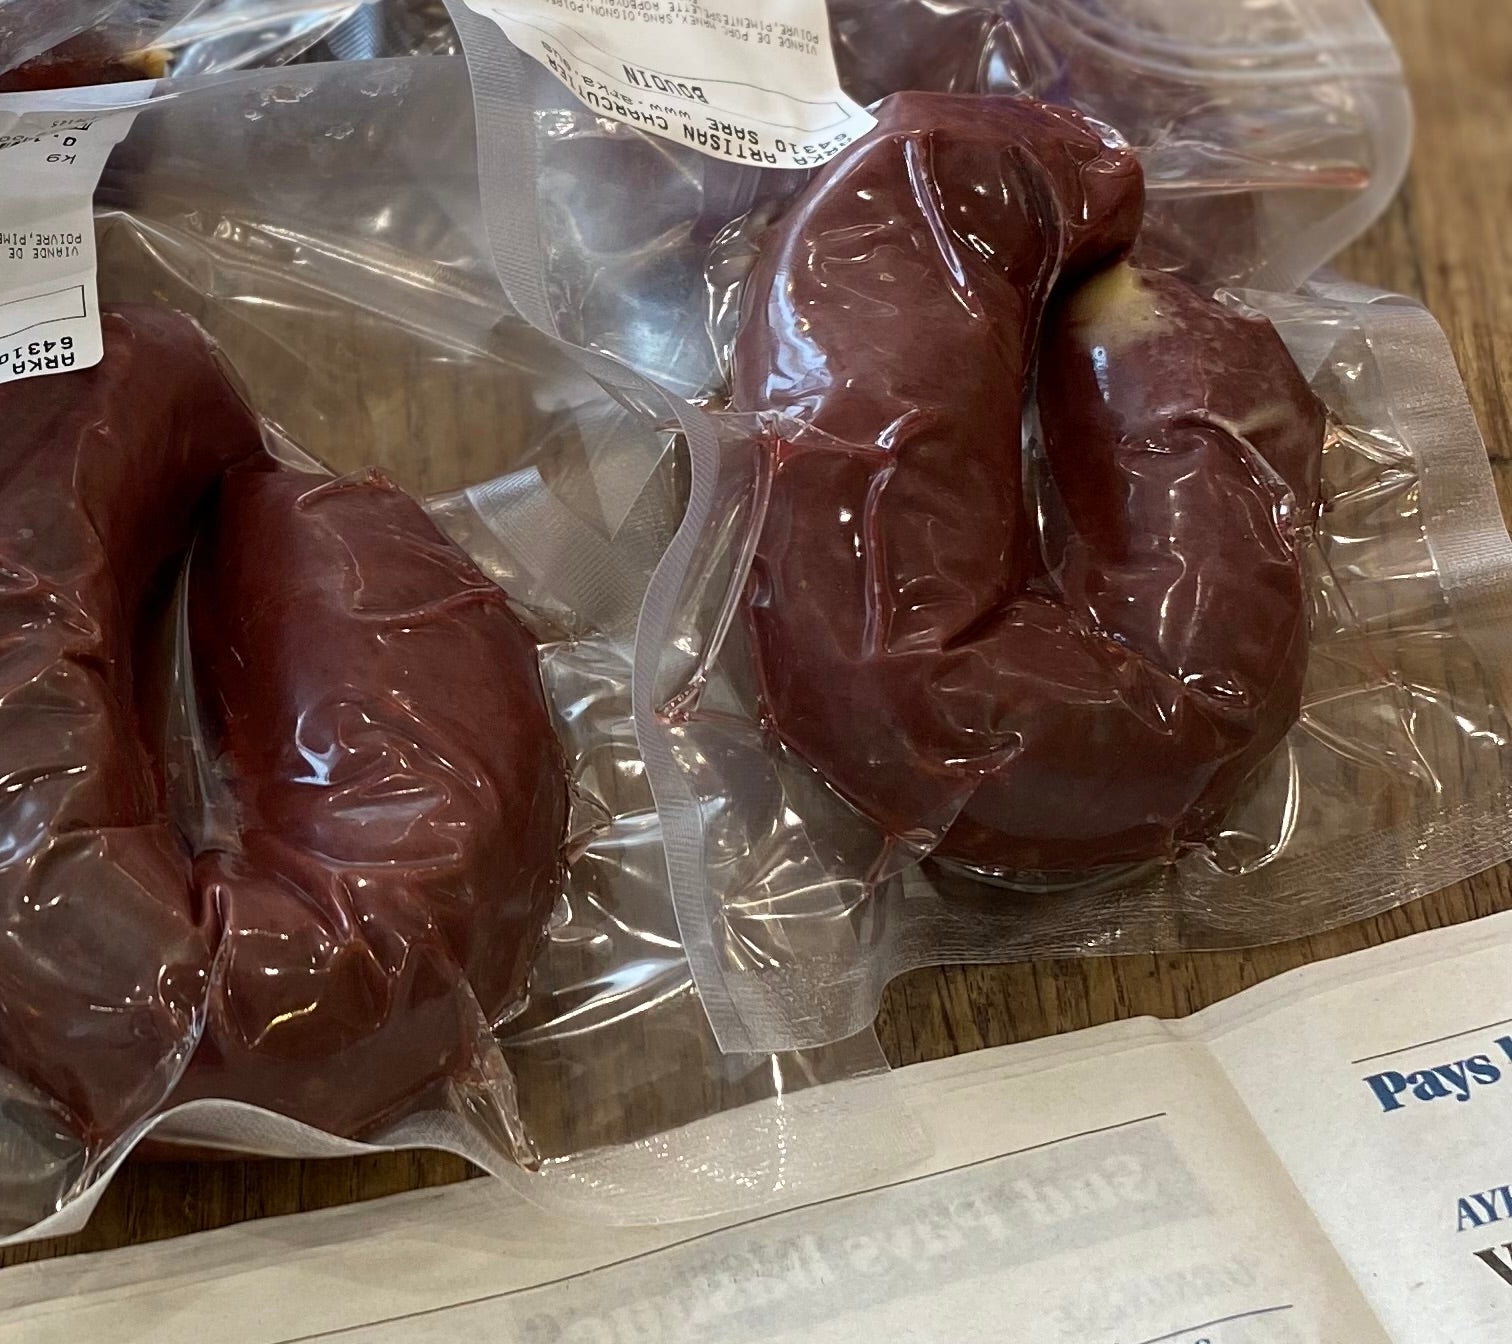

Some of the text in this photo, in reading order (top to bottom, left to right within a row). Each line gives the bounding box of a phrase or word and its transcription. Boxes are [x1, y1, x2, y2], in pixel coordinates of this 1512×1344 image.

[755, 32, 770, 47] DE
[778, 37, 817, 55] VIANDE
[547, 55, 668, 130] CHARCUTIER
[622, 65, 709, 103] BOUDIN
[705, 118, 758, 143] SARE
[683, 123, 776, 164] ARTISAN
[774, 133, 847, 154] 64310
[8, 247, 23, 259] DE
[32, 246, 79, 259] VIANDE
[12, 352, 75, 375] ARKA
[1361, 1052, 1502, 1114] Pays
